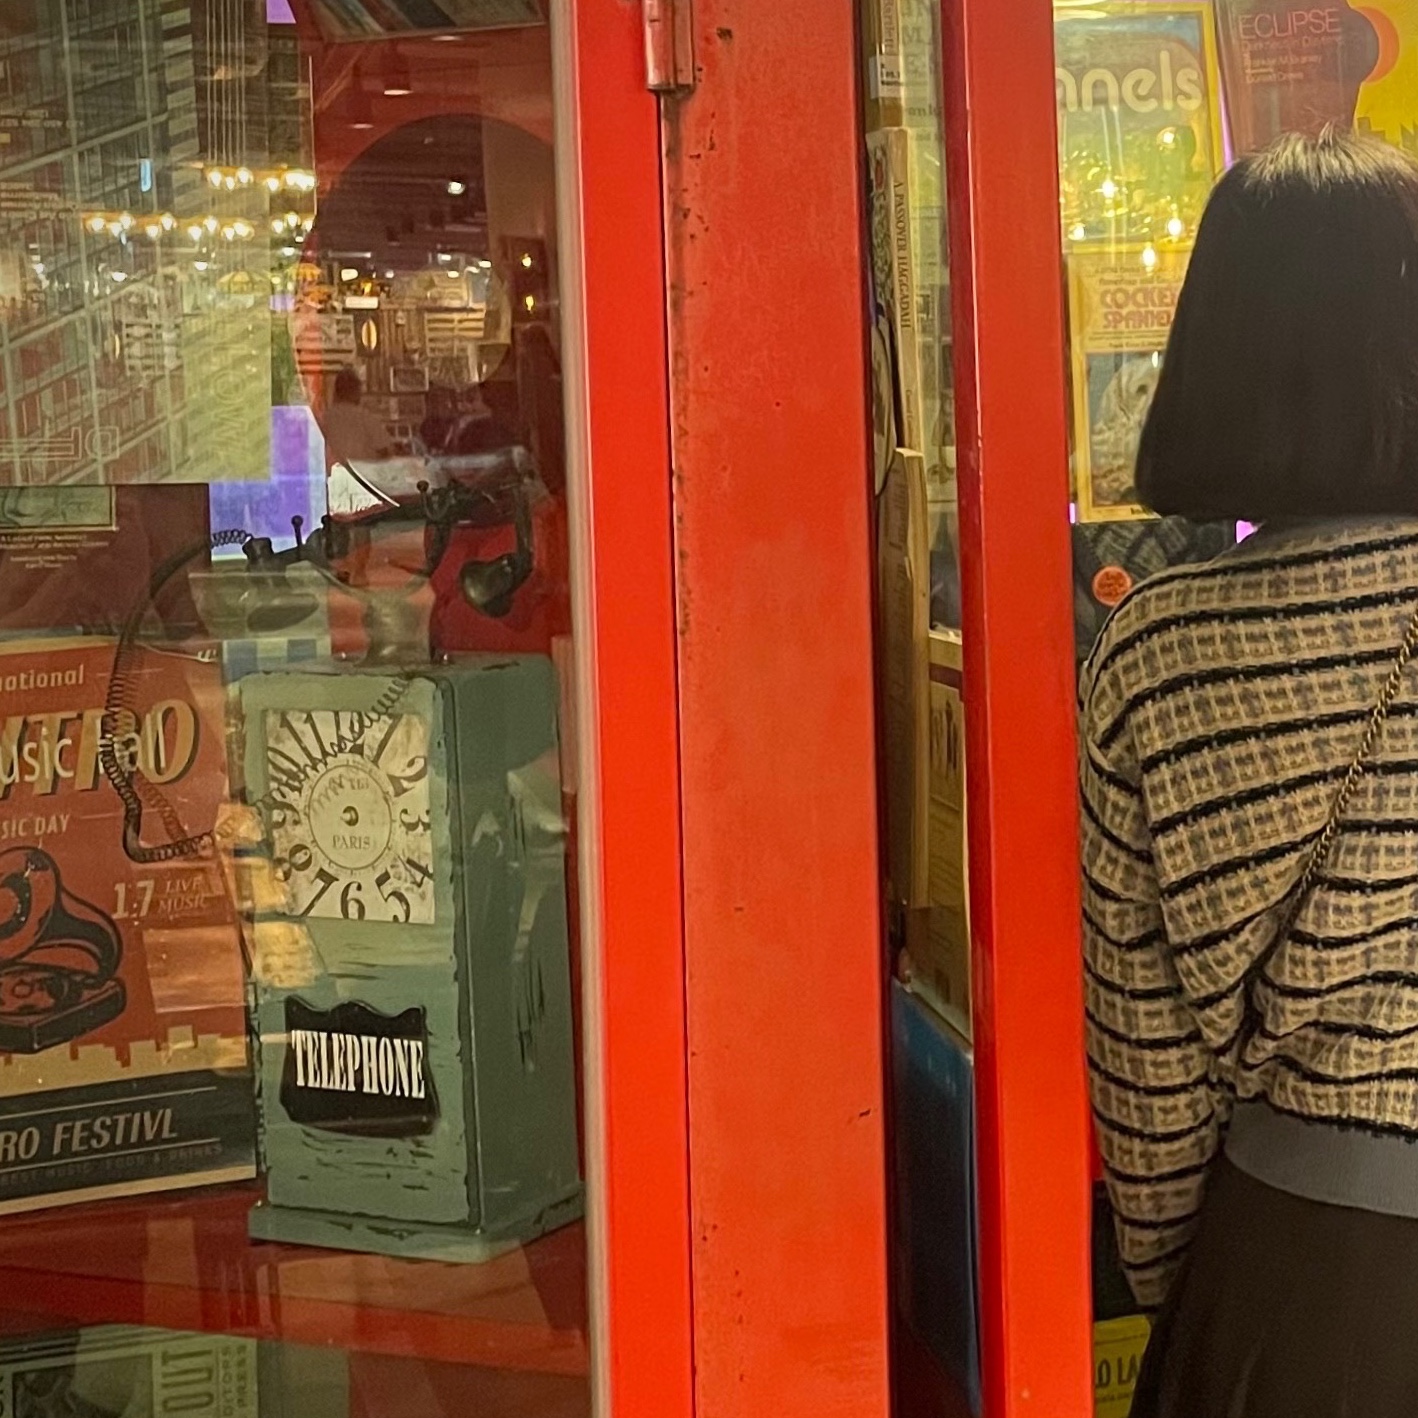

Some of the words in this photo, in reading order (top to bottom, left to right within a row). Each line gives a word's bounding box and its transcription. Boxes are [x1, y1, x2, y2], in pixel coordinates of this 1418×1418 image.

[1239, 9, 1341, 39] ECLIPSE
[895, 194, 908, 250] PASSOVER
[898, 254, 913, 328] HAGGADAH
[387, 755, 428, 798] 2
[35, 813, 70, 836] DAY
[332, 835, 371, 850] PARIS
[112, 879, 155, 920] 17
[165, 876, 203, 894] LIVE
[158, 893, 207, 914] MUSIC
[301, 867, 340, 917] 7
[341, 881, 366, 921] 6
[375, 867, 411, 922] 5
[291, 1029, 426, 1099] TELEPHONE
[52, 1108, 179, 1156] FESTIVL
[235, 1345, 247, 1408] PRESS
